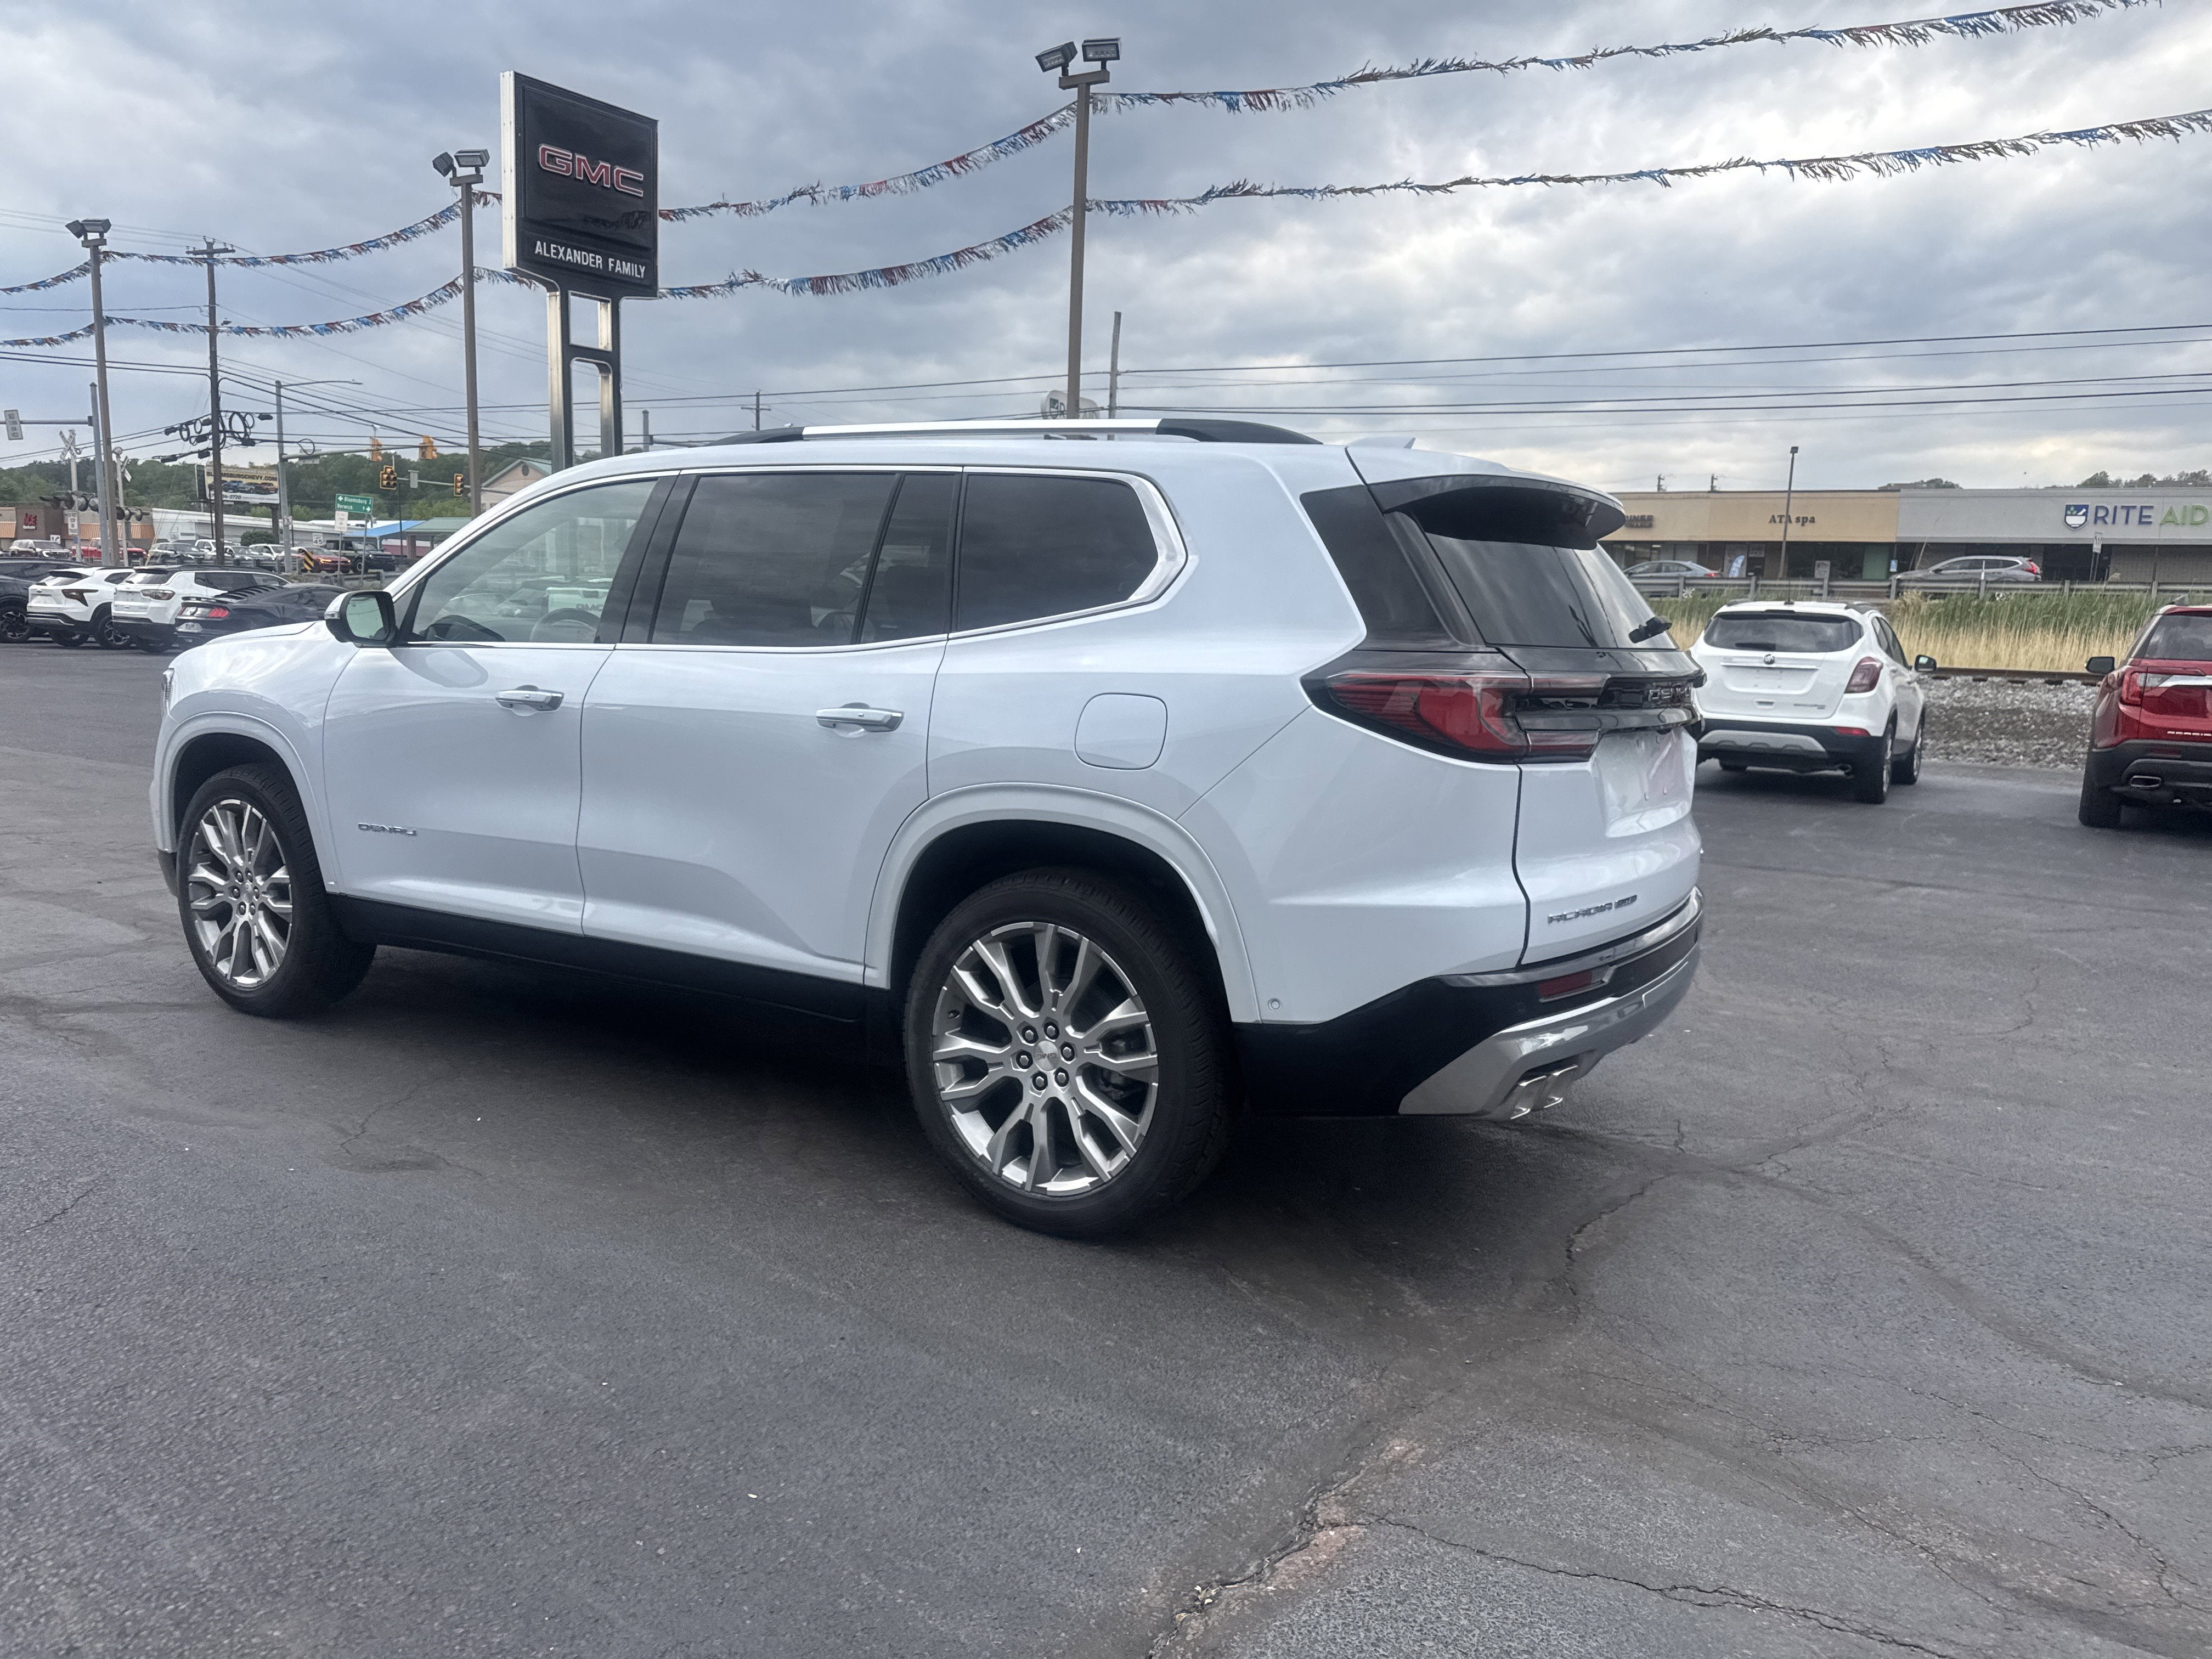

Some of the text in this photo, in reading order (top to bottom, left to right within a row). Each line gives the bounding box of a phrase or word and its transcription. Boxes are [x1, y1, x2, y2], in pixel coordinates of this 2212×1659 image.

[539, 144, 644, 196] GMC
[535, 241, 646, 278] ALEXANDER FAMILY
[206, 472, 278, 481] BLMSBURGCHEVY.COM
[344, 496, 367, 505] Bloomsburg
[1768, 515, 1815, 527] ATA spa
[2094, 505, 2209, 525] RITE AID
